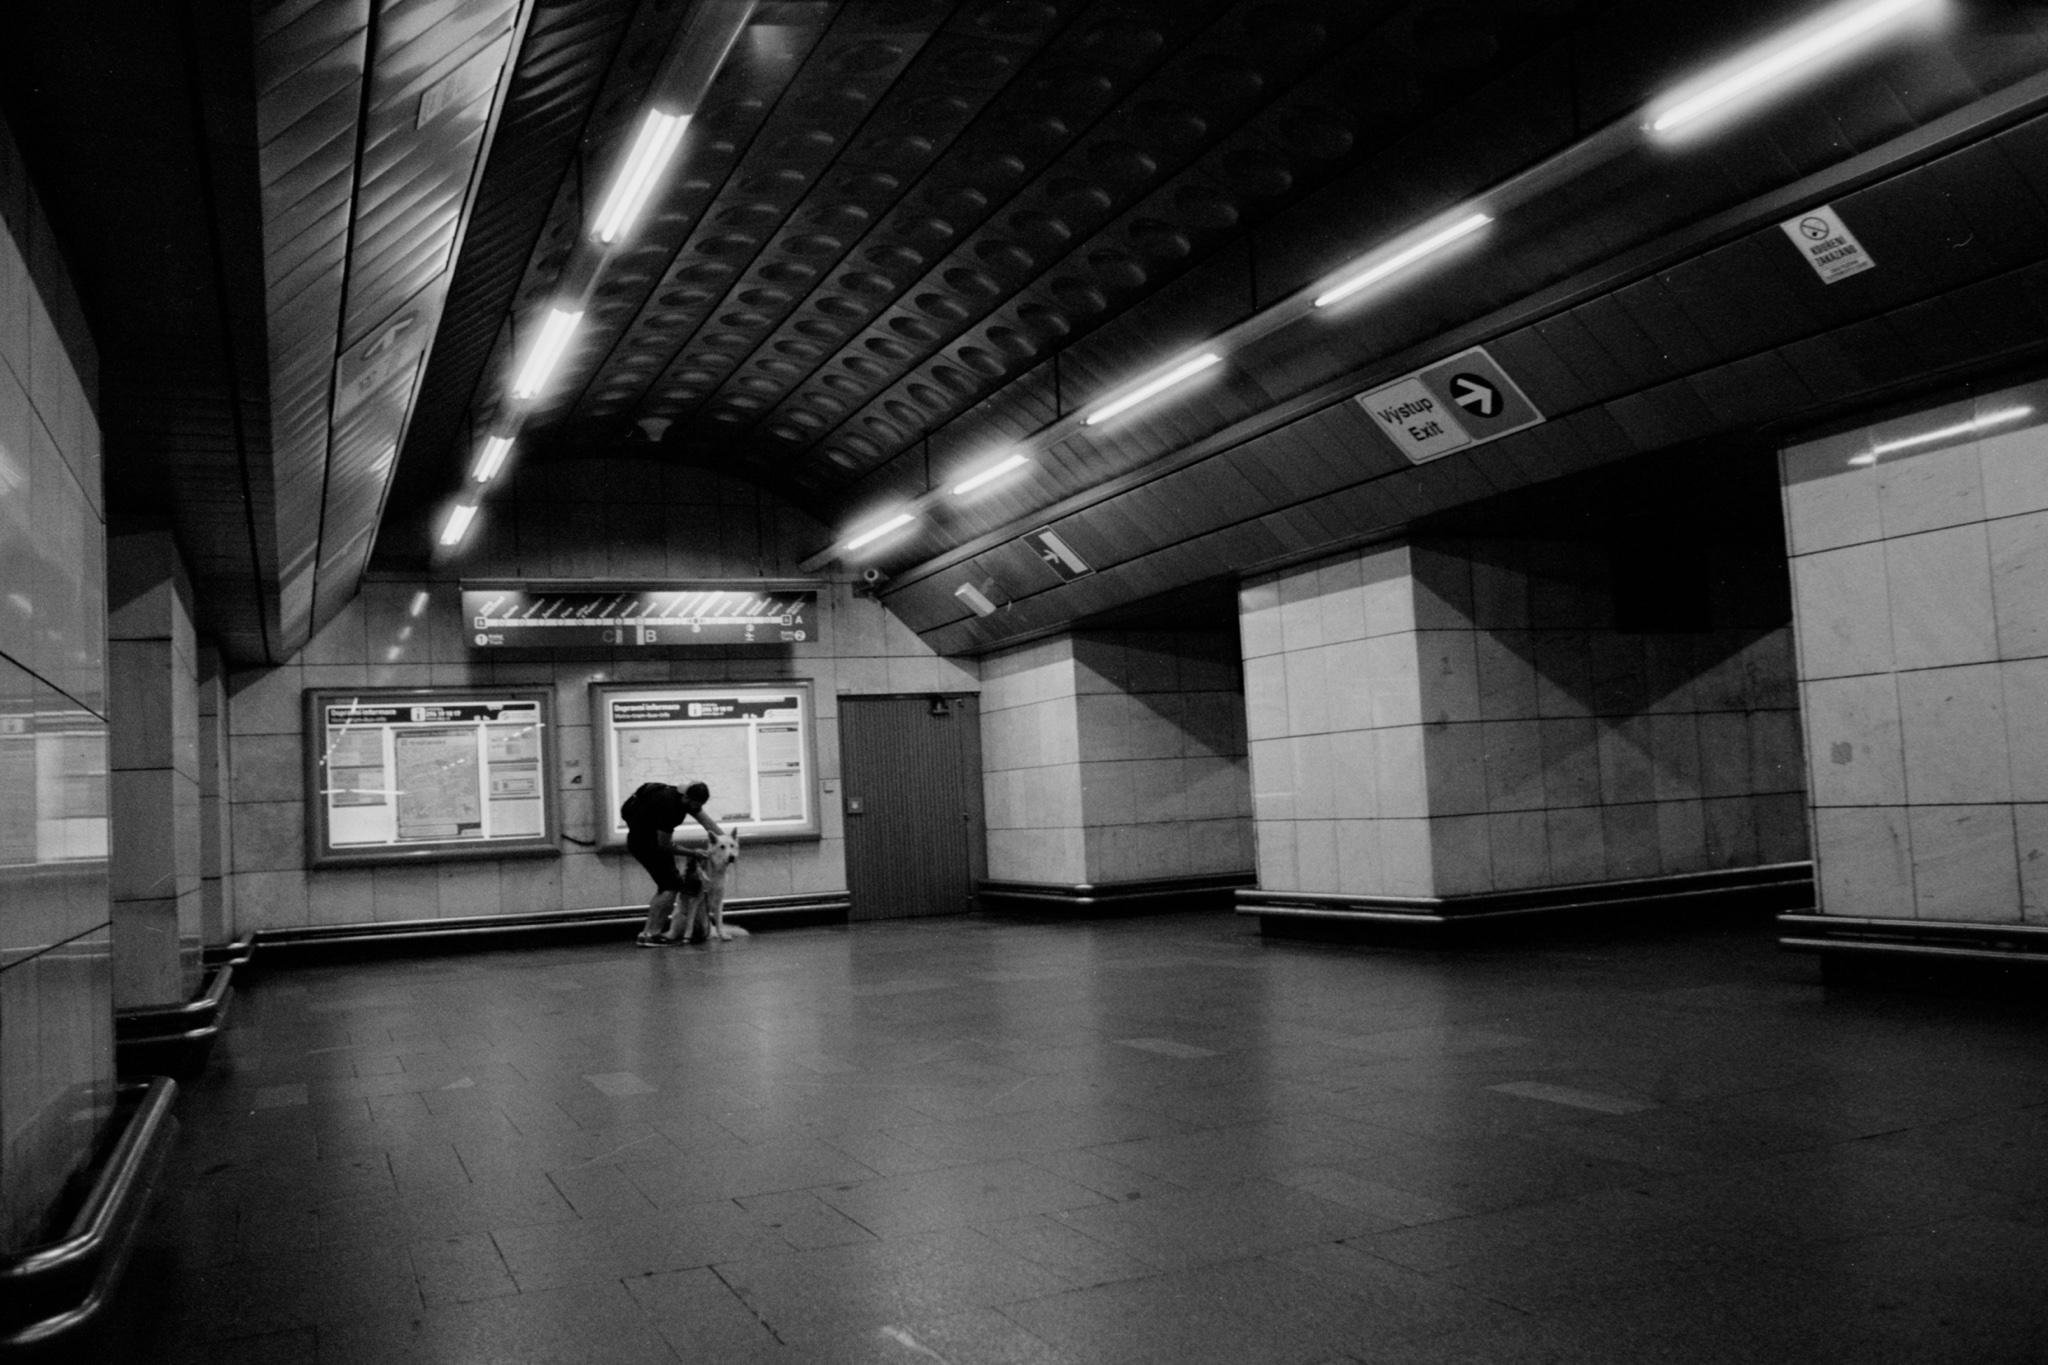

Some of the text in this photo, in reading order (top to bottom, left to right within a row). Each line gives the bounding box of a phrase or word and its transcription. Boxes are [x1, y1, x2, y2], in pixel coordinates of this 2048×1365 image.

[1377, 398, 1434, 425] Výstup
[1408, 421, 1444, 441] Exit
[795, 615, 803, 624] A
[602, 629, 614, 643] C
[645, 629, 657, 643] B
